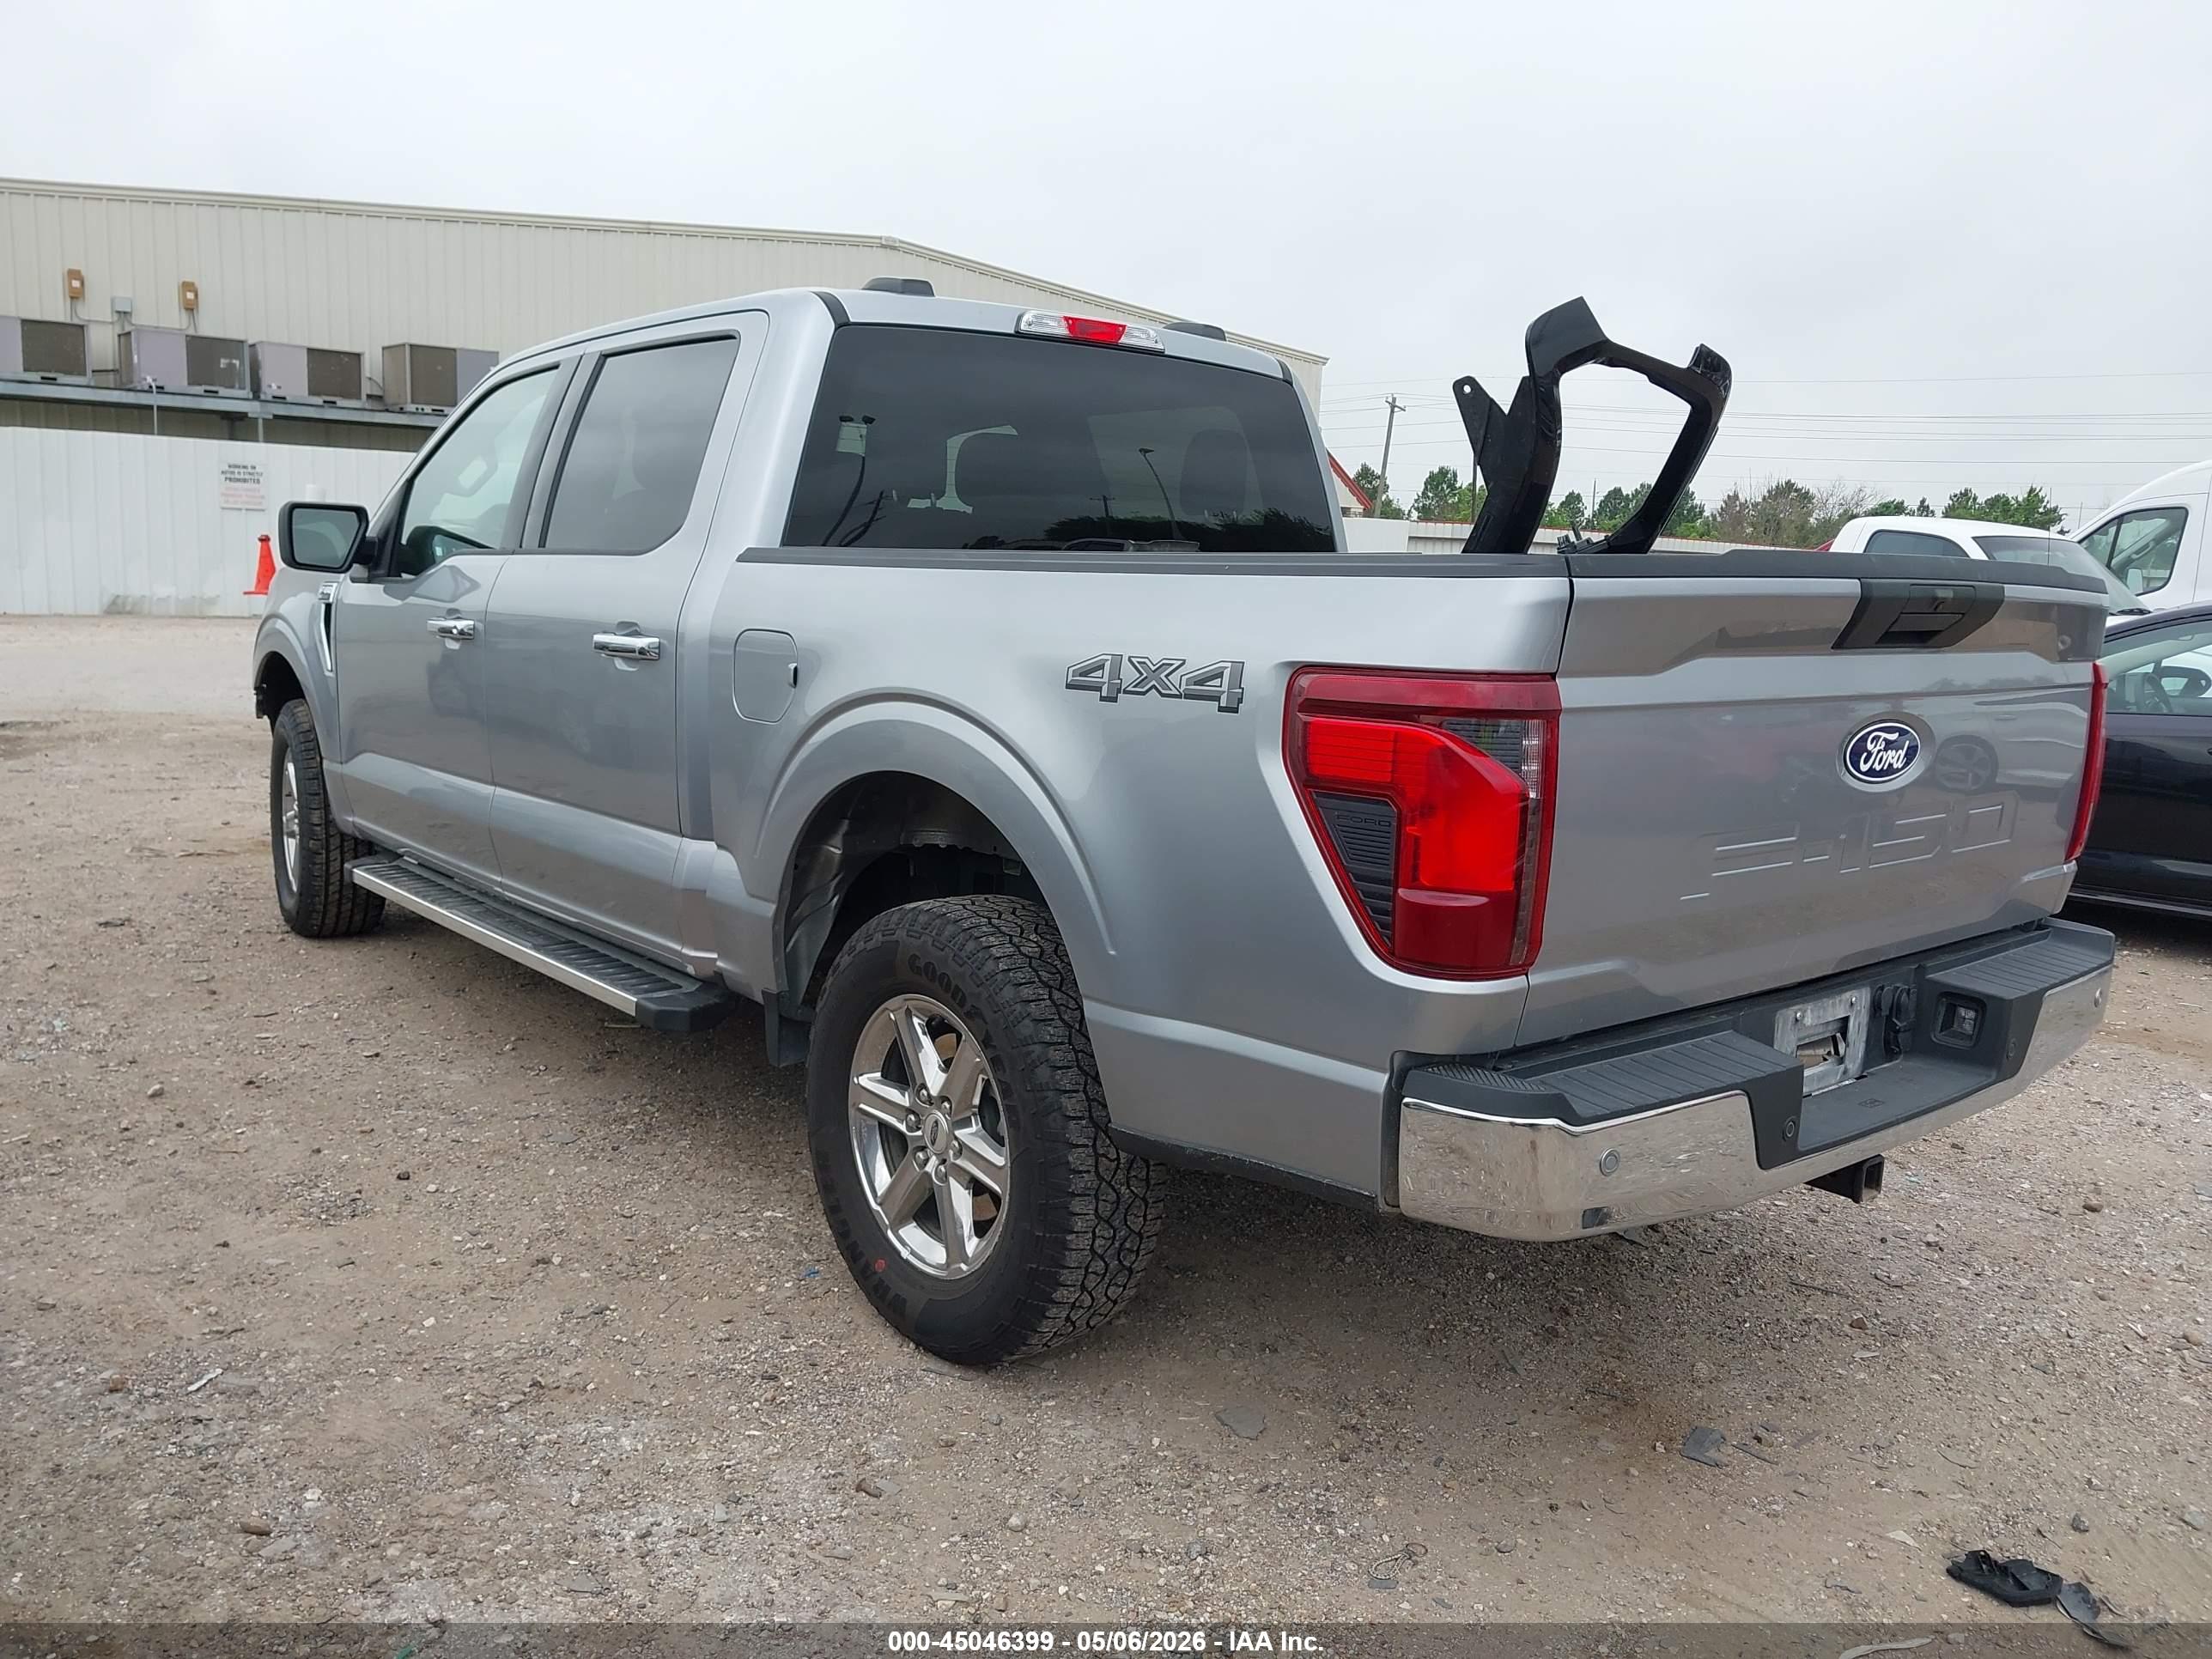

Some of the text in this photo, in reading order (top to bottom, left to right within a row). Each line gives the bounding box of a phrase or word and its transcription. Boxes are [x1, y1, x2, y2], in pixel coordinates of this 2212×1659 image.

[1065, 653, 1245, 714] 4X4
[1859, 731, 1910, 772] Ford
[1335, 812, 1391, 827] FORD
[1680, 793, 2017, 900] F-150
